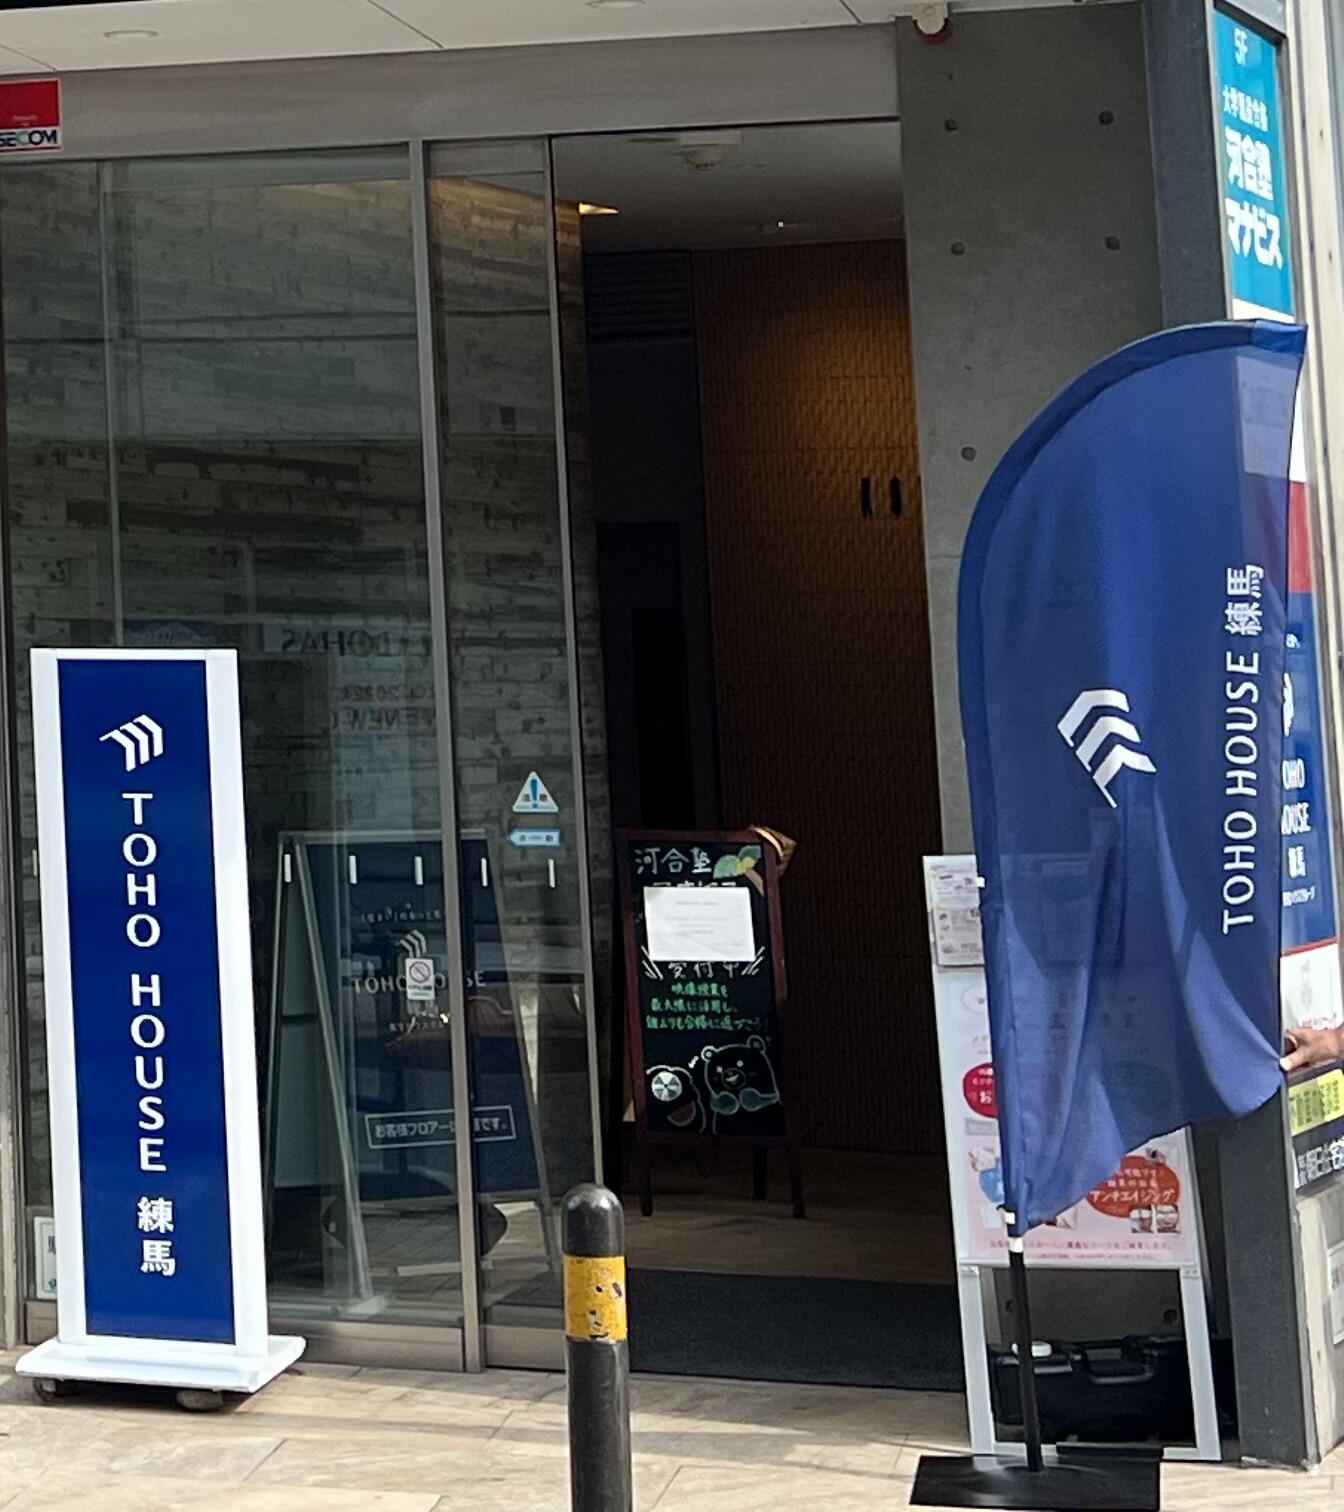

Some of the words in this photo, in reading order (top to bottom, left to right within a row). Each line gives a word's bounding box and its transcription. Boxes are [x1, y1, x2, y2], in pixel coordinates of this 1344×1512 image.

[1225, 198, 1283, 270] マナビス
[1225, 563, 1264, 637] 練馬
[1225, 650, 1260, 793] HOUSE
[121, 792, 162, 949] TOHO
[634, 846, 712, 875] 河合塾
[1222, 809, 1257, 934] TOHO
[129, 973, 167, 1173] HOUSE
[137, 1195, 176, 1277] 練馬
[1089, 1188, 1175, 1204] アンチエイジング
